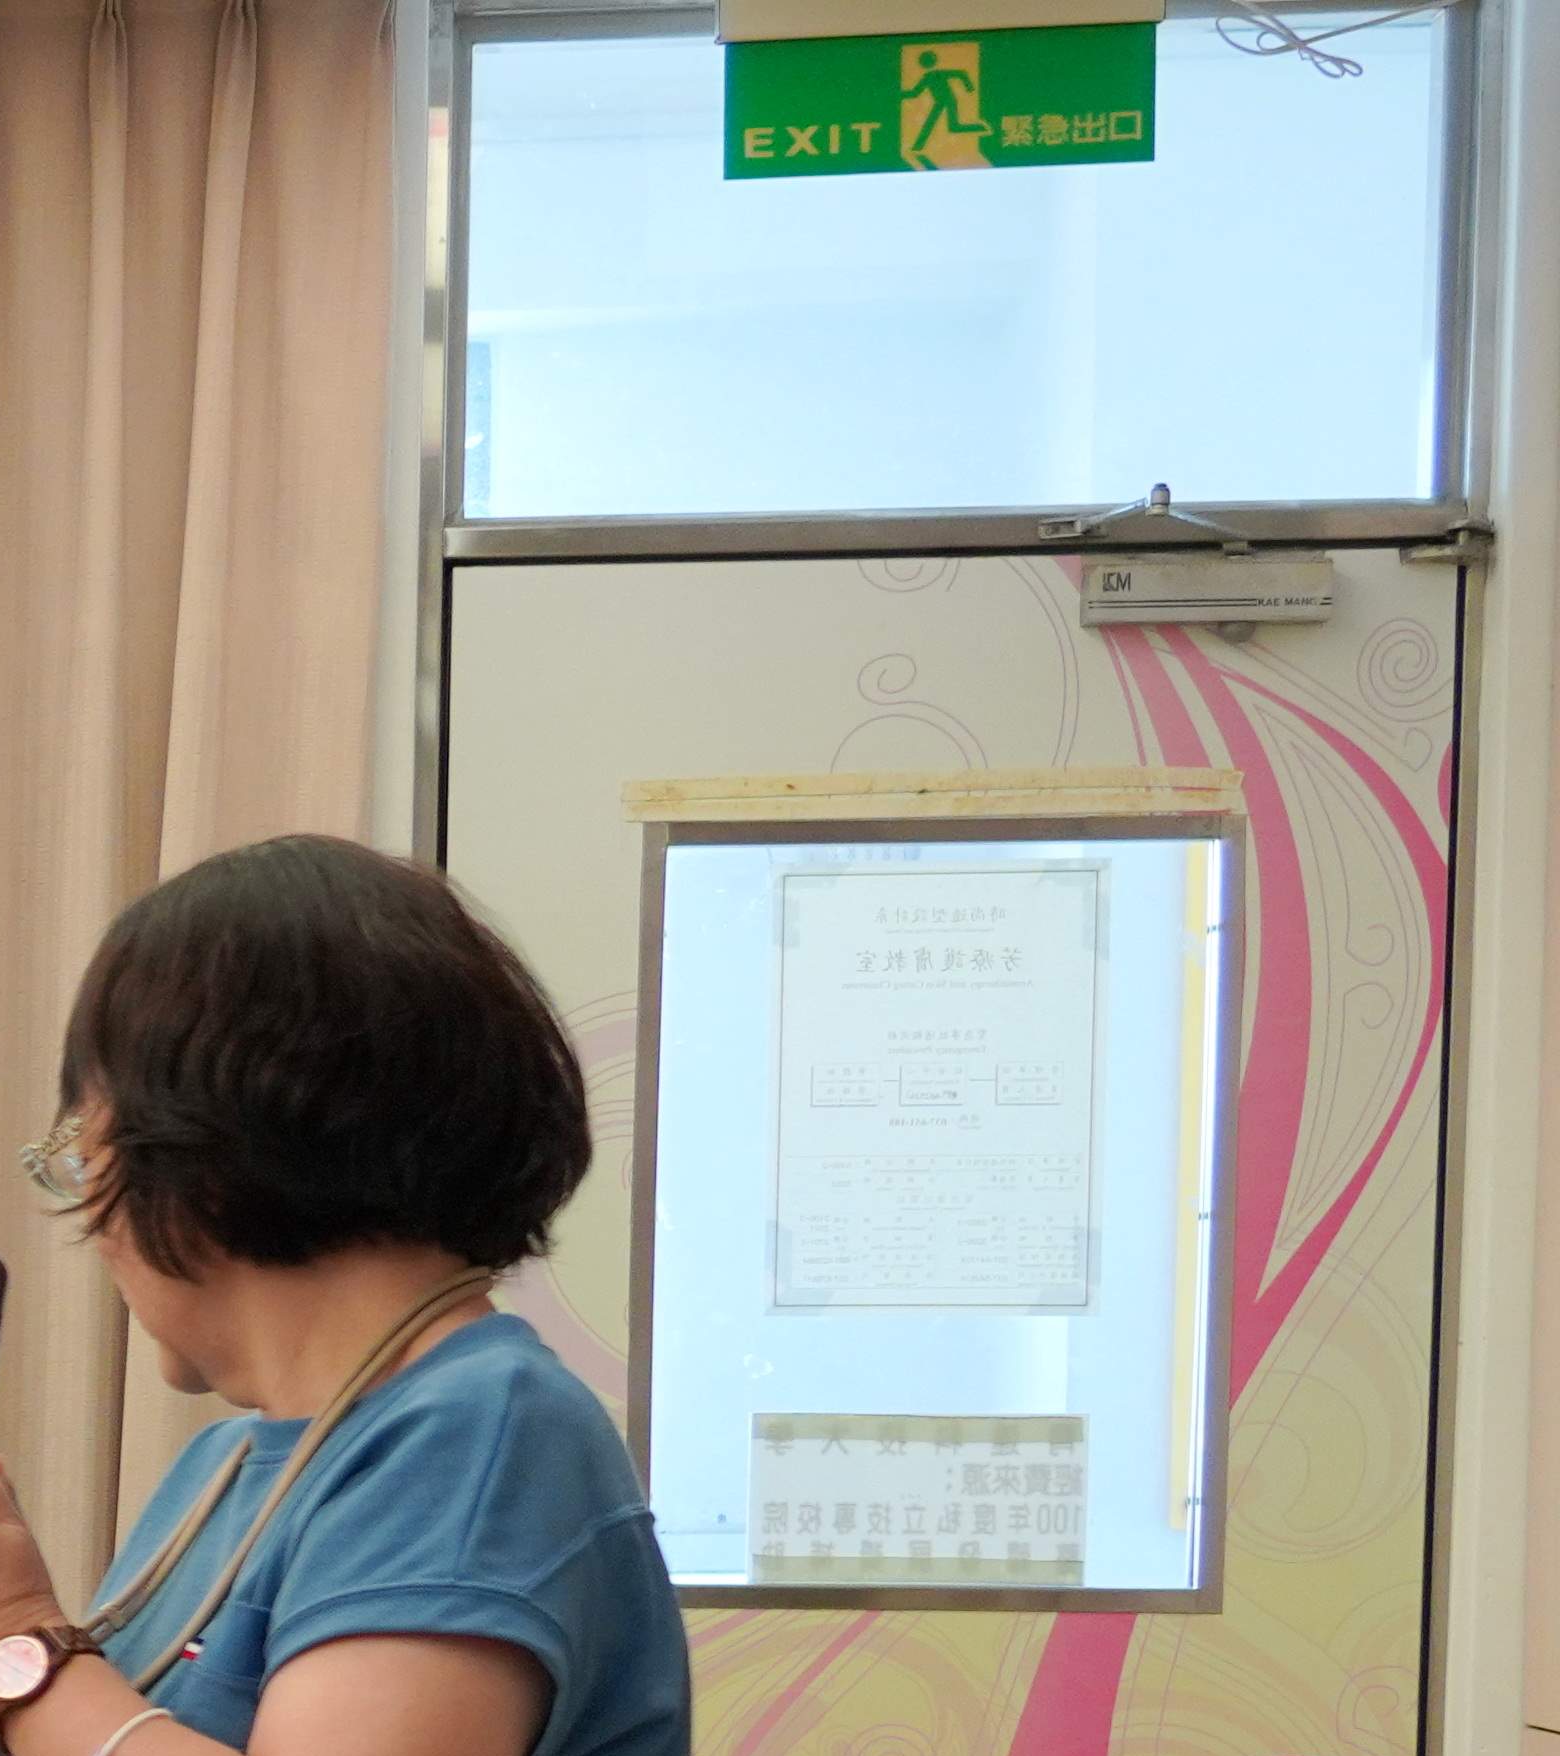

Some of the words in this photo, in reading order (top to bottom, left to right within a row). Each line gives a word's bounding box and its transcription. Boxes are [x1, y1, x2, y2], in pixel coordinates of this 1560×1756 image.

[743, 121, 881, 158] EXIT
[1001, 110, 1143, 147] 緊急出口
